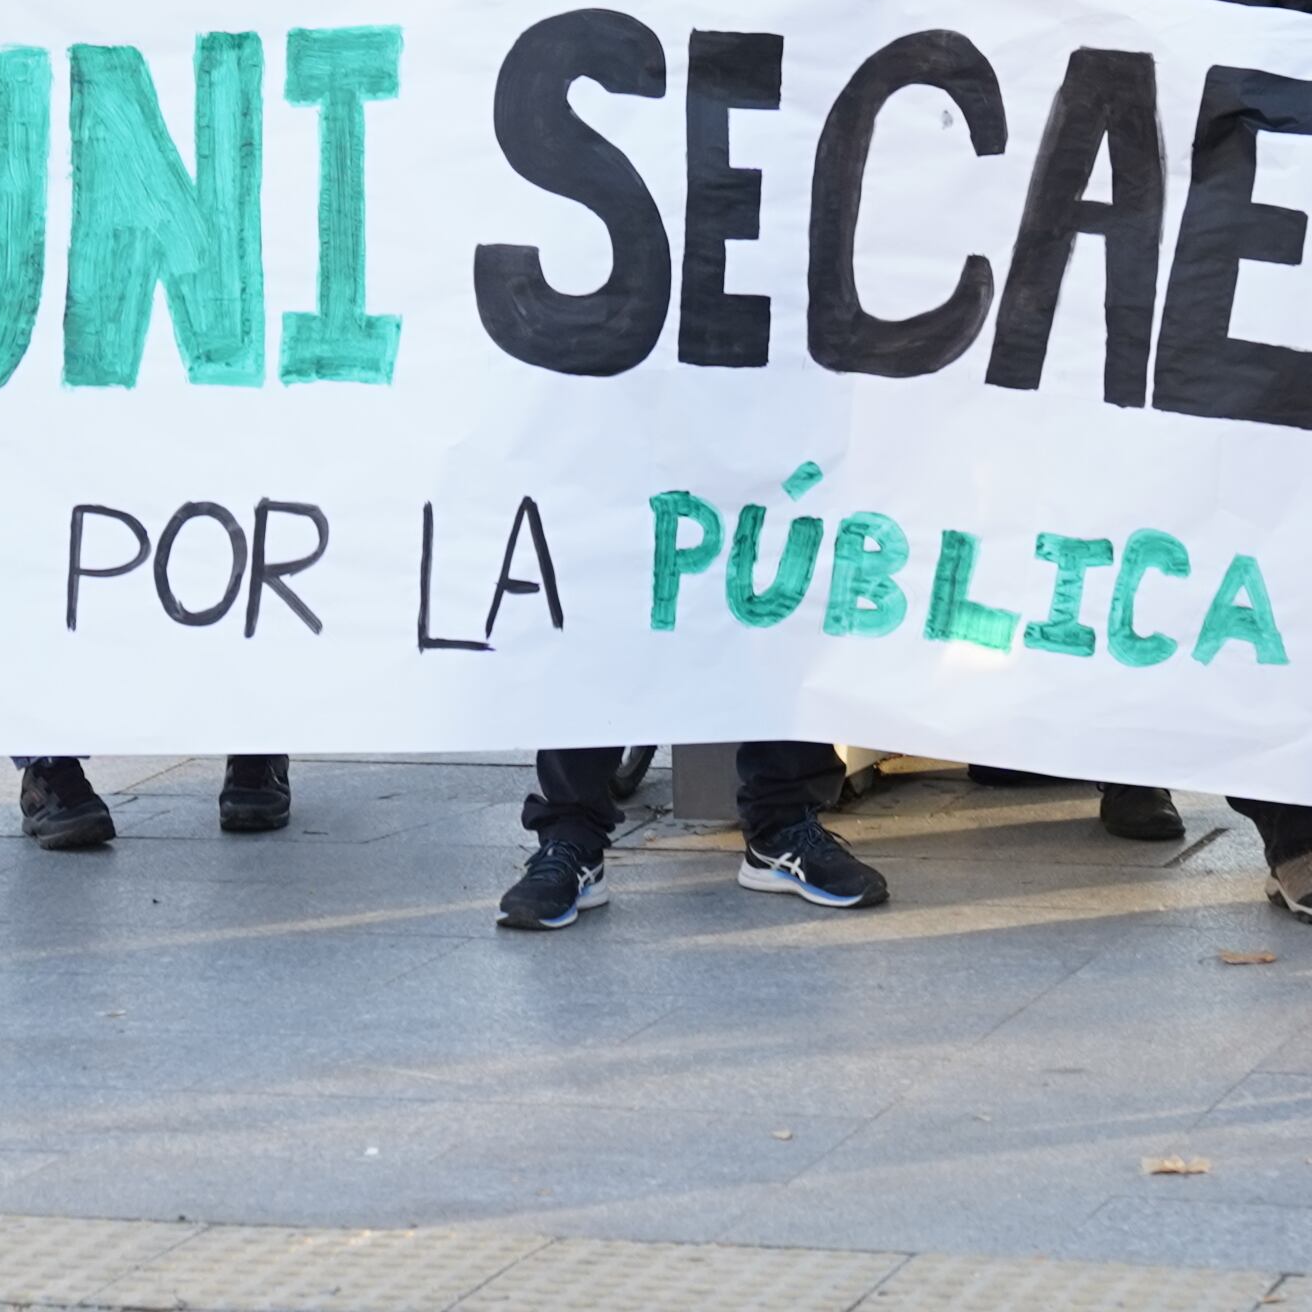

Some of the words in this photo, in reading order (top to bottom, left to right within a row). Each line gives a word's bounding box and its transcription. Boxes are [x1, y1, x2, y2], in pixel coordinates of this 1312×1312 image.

[67, 496, 330, 639] POR
[417, 495, 565, 654] LA
[649, 460, 1290, 668] PÚBLICA
